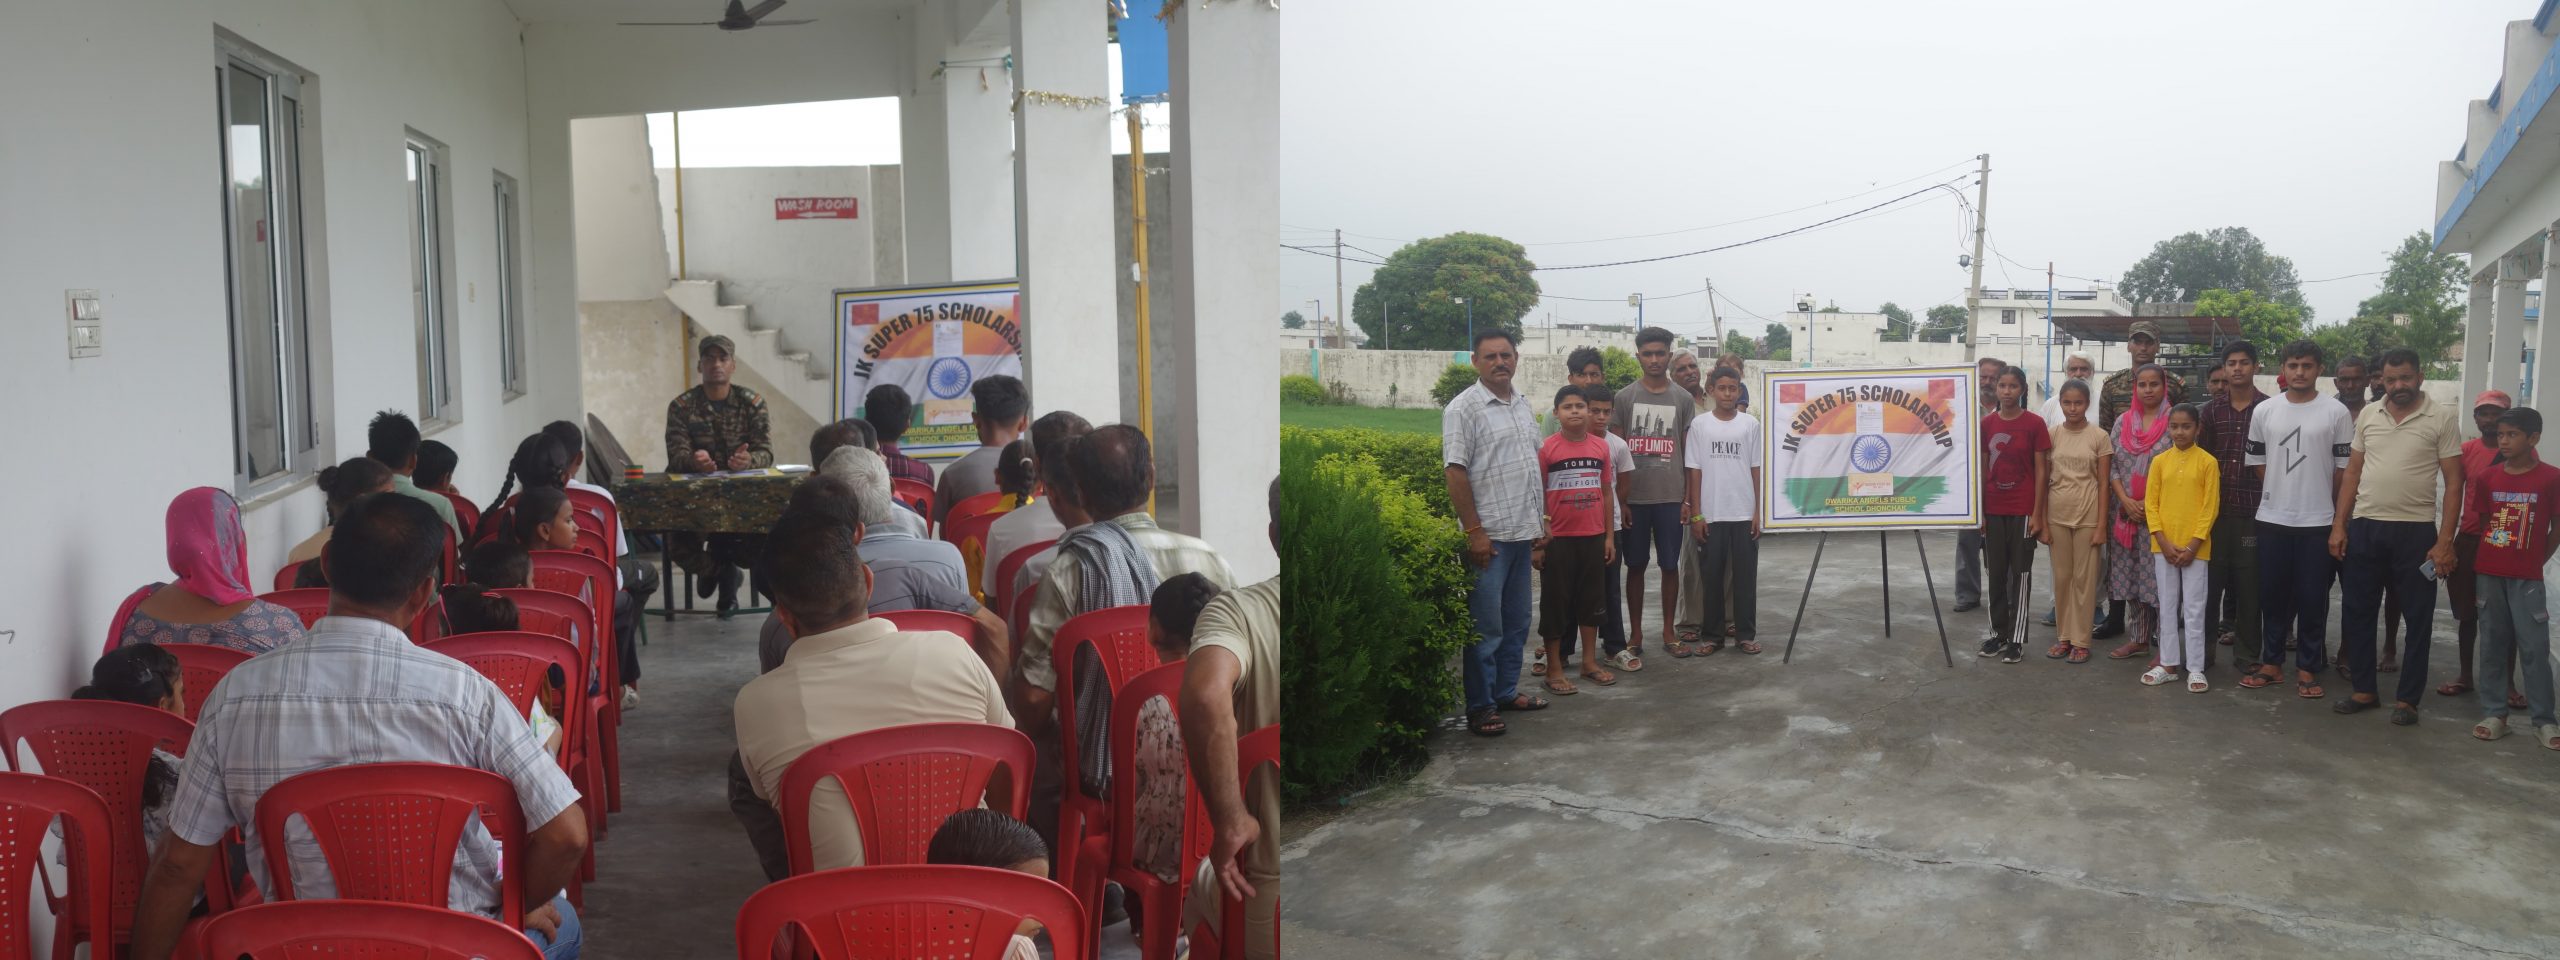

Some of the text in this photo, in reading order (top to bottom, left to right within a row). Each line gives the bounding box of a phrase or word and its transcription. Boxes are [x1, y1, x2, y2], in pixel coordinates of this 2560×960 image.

[777, 199, 854, 211] WASH ROOM
[854, 358, 874, 380] JK
[864, 313, 913, 358] SUPER
[913, 305, 934, 324] 75
[939, 302, 1022, 364] SCHOLARS
[1836, 386, 1857, 405] 75
[1791, 393, 1836, 434] SUPER
[1860, 384, 1953, 450] SCHOLARSHIP
[1629, 438, 1674, 453] OFF LIMITS
[1782, 433, 1801, 453] JK
[1564, 460, 1598, 468] TOMMY
[1559, 479, 1599, 488] HILFIGER
[1860, 496, 1889, 504] ANGELS
[1890, 495, 1917, 504] PUBLIC
[1835, 504, 1865, 513] SCHOOL
